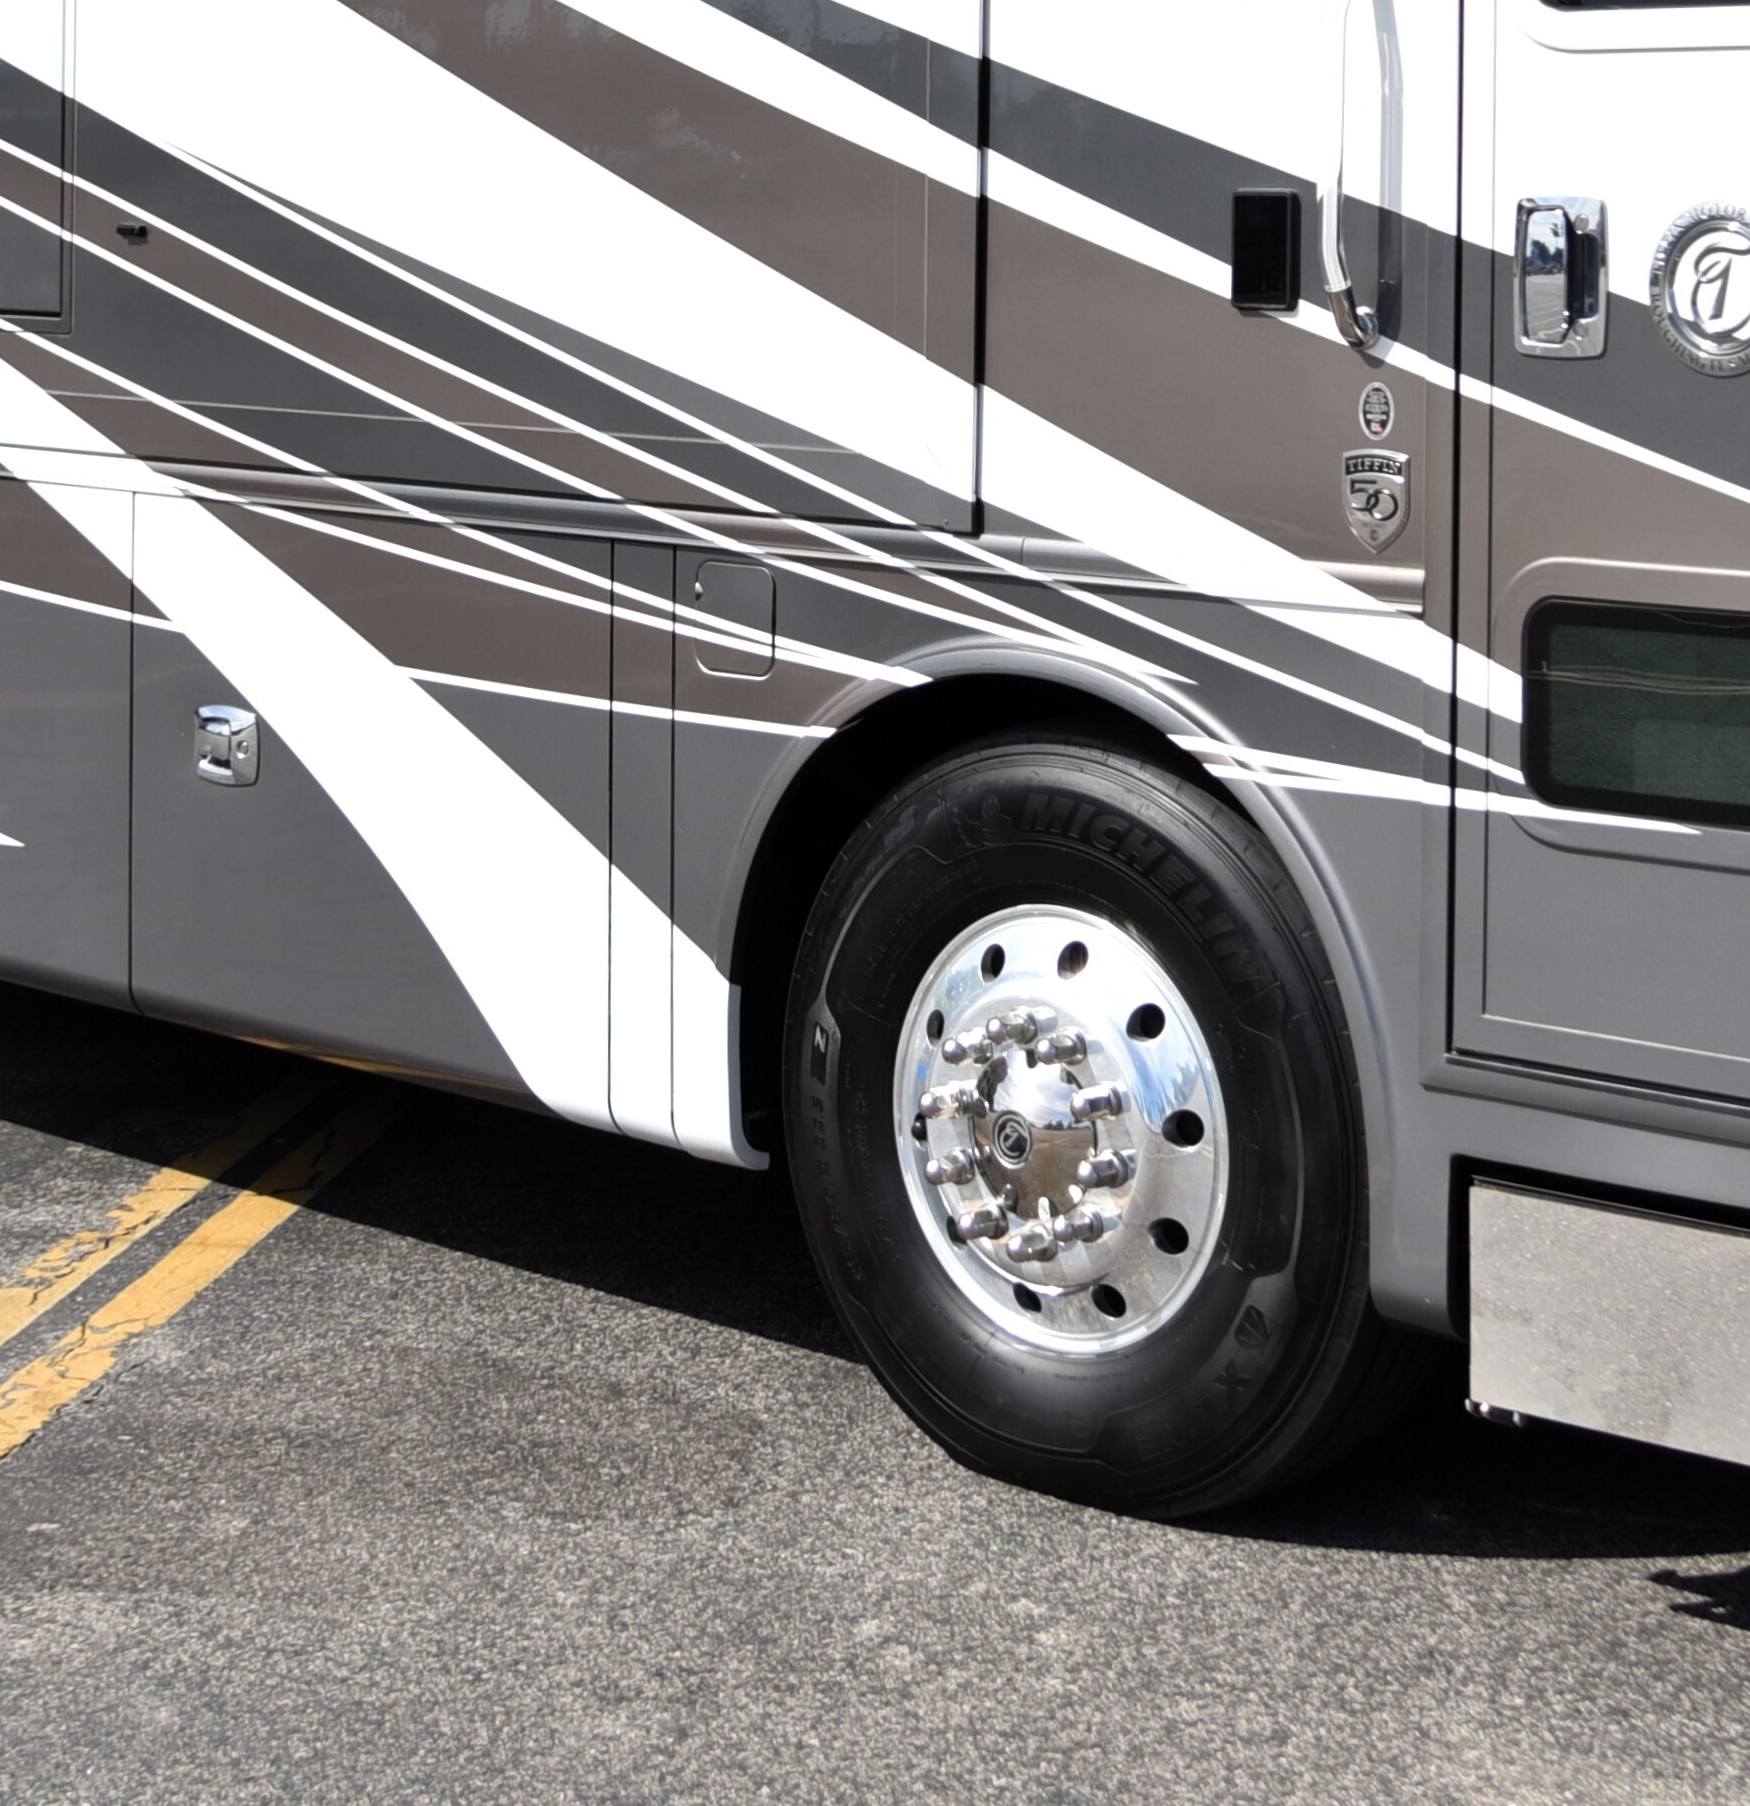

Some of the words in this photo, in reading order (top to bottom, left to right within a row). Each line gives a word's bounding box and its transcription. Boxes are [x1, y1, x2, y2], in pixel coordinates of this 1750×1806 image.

[1346, 457, 1403, 475] TIFFIN
[1350, 479, 1399, 522] 50
[1018, 790, 1268, 984] MICHELIN
